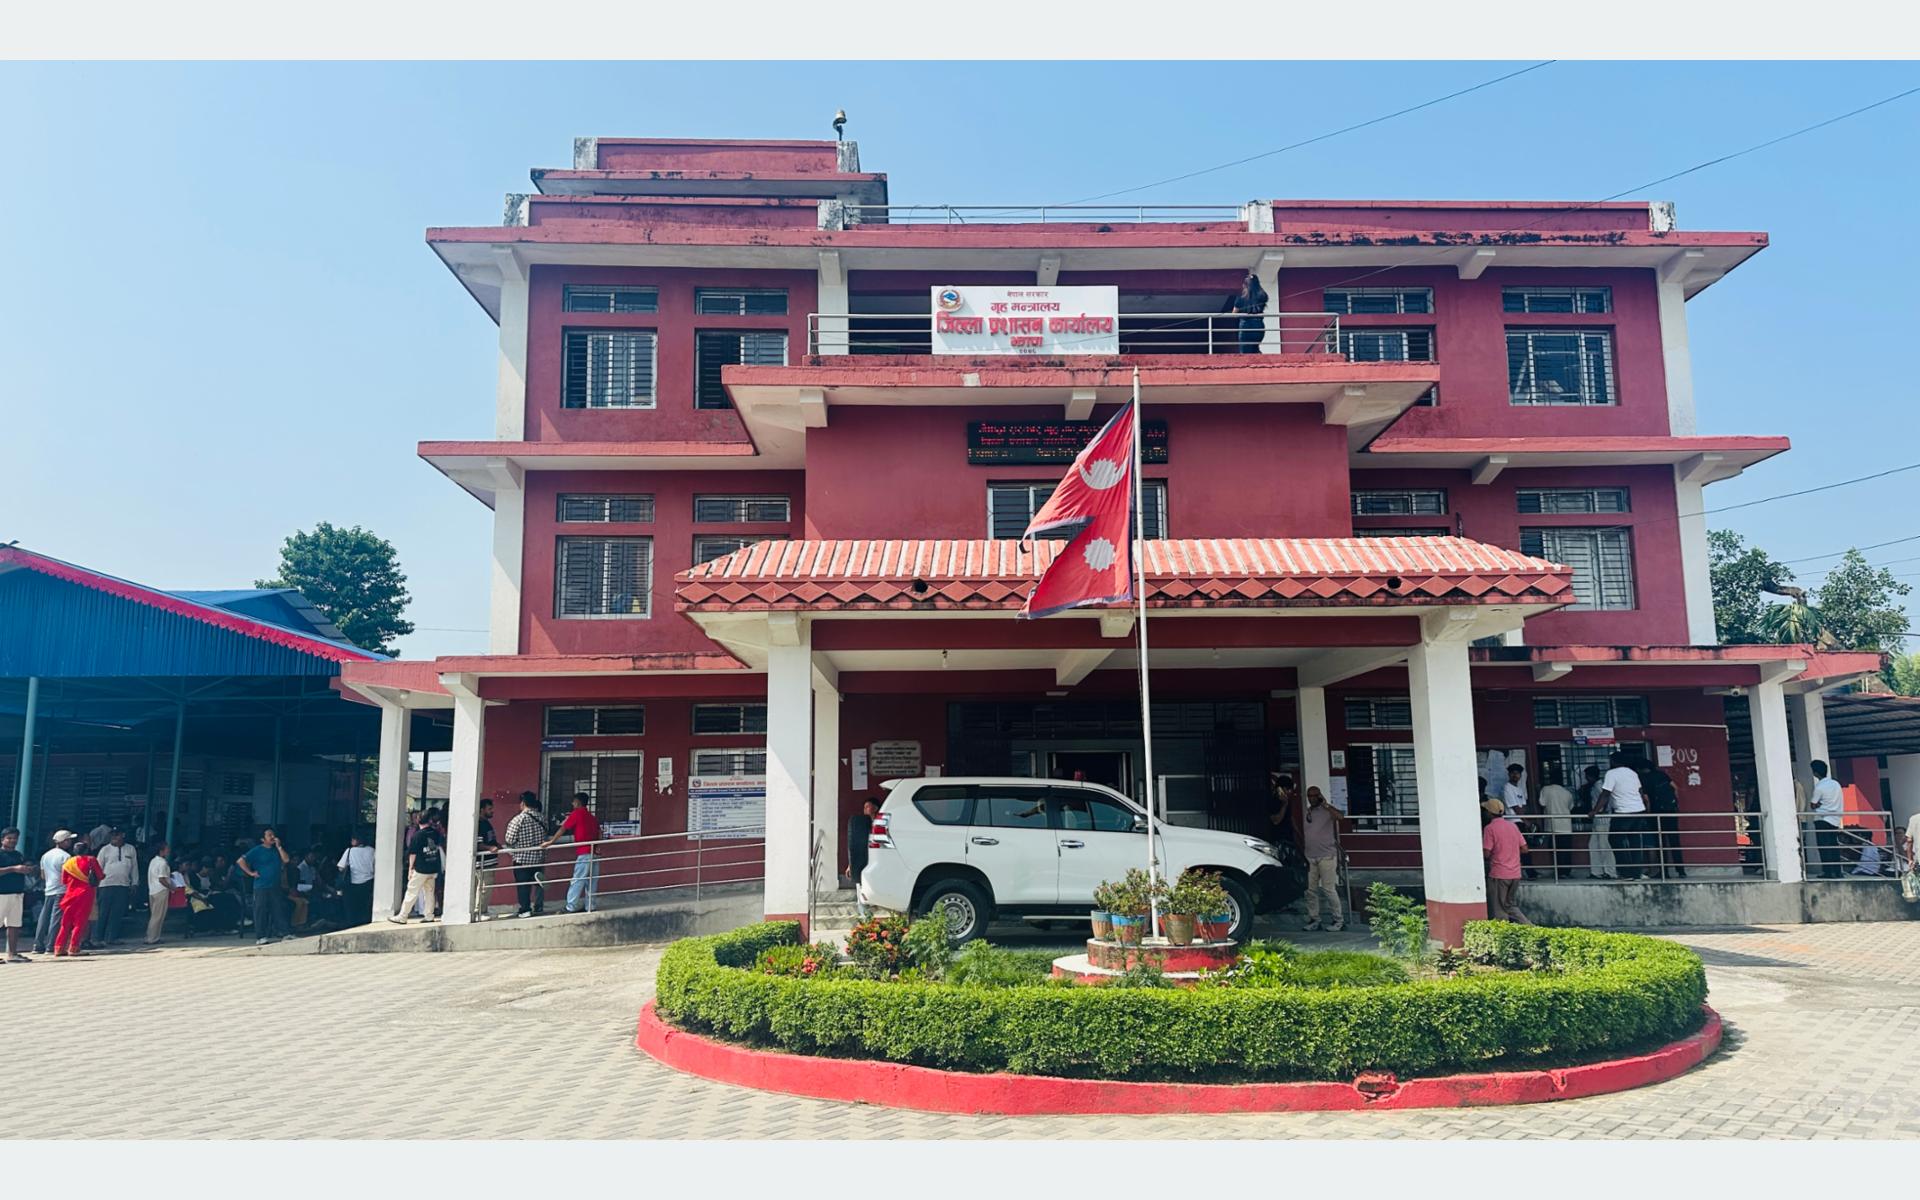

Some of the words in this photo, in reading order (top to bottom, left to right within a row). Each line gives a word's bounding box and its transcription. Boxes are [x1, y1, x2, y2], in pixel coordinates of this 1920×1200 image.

[990, 302, 1008, 313] गृह
[1011, 302, 1061, 312] मन्त्रालय
[937, 311, 983, 334] जिल्ला
[989, 317, 1043, 336] प्रशासन
[1049, 313, 1113, 334] कार्यालय
